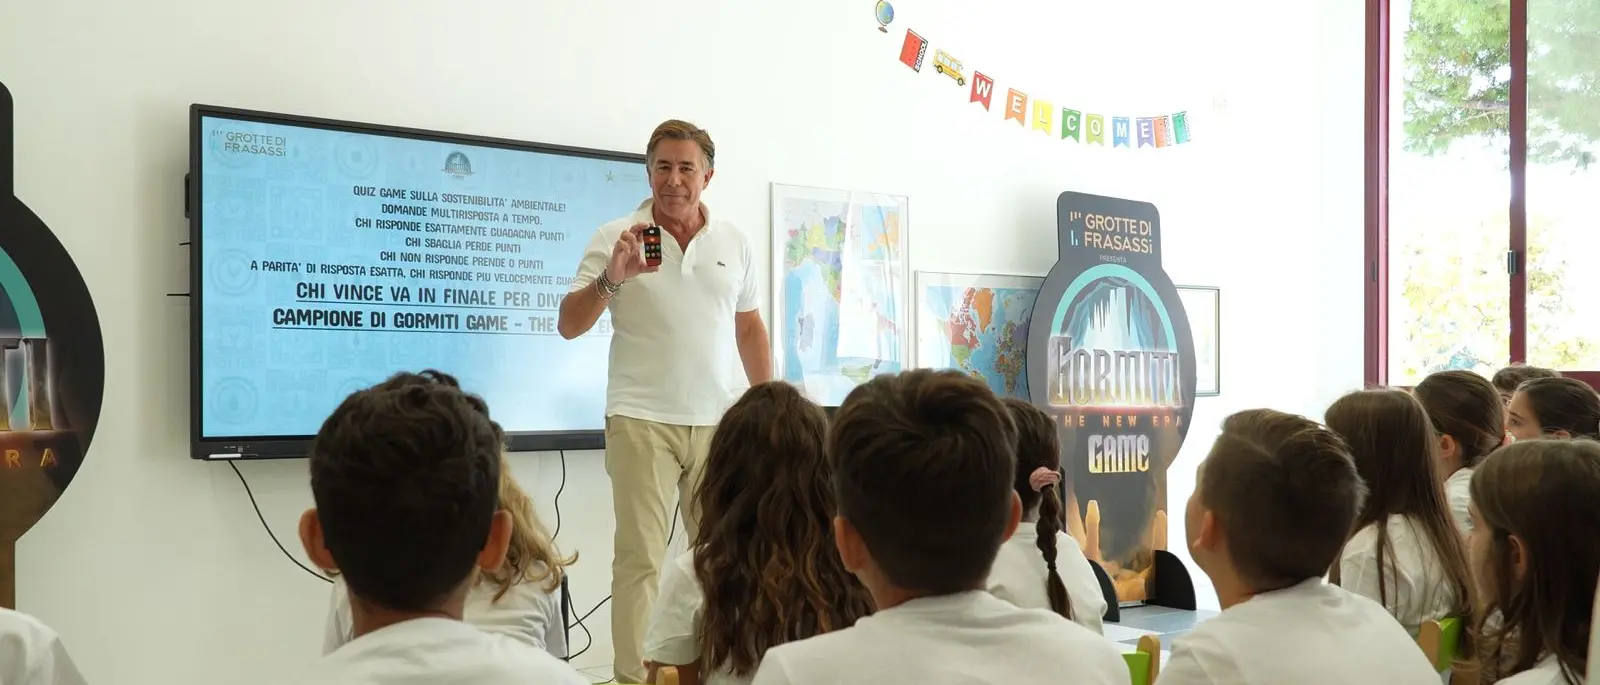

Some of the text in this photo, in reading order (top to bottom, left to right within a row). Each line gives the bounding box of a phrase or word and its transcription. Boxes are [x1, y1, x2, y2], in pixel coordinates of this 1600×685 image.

[226, 131, 287, 147] GROTTE DI
[353, 185, 376, 197] QUIZ
[379, 187, 407, 200] GAME
[410, 189, 438, 202] SULLA
[511, 200, 566, 213] AMBIENTALE!
[381, 203, 542, 225] DOMANDE MULTIRISPOSTA A TEMPO.
[1085, 213, 1152, 237] GROTTE DI
[355, 217, 564, 241] CHI RISPONDE ESATTAMENTE GUADAGNA PUNTI
[405, 236, 521, 253] CHI SBAGLIA PERDE PUNTI
[380, 250, 396, 262] CHI
[400, 251, 421, 263] NON
[424, 253, 469, 266] RISPONDE
[472, 256, 505, 268] PRENDE
[518, 258, 544, 270] PUNTI
[1099, 254, 1127, 264] PRESENTA
[250, 260, 258, 271] A
[306, 263, 316, 273] DI
[320, 263, 367, 276] RISPOSTA
[409, 268, 426, 279] CHI
[429, 269, 473, 282] RISPONDE
[476, 272, 491, 282] PIU
[494, 273, 553, 285] VELOCEMENTE
[556, 276, 576, 286] GUA
[296, 281, 325, 299] CHI
[333, 283, 384, 301] VINCE
[390, 286, 411, 303] VA
[418, 287, 436, 303] IN
[443, 288, 496, 306] FINALE
[503, 291, 531, 307] PER
[273, 308, 363, 328] CAMPIONE
[370, 311, 386, 328] DI
[393, 312, 459, 330] GORMITI
[466, 314, 508, 332] GAME
[528, 316, 555, 332] THE
[1048, 335, 1182, 406] GORMITI
[1103, 415, 1137, 428] NEW
[1152, 415, 1183, 428] ERA
